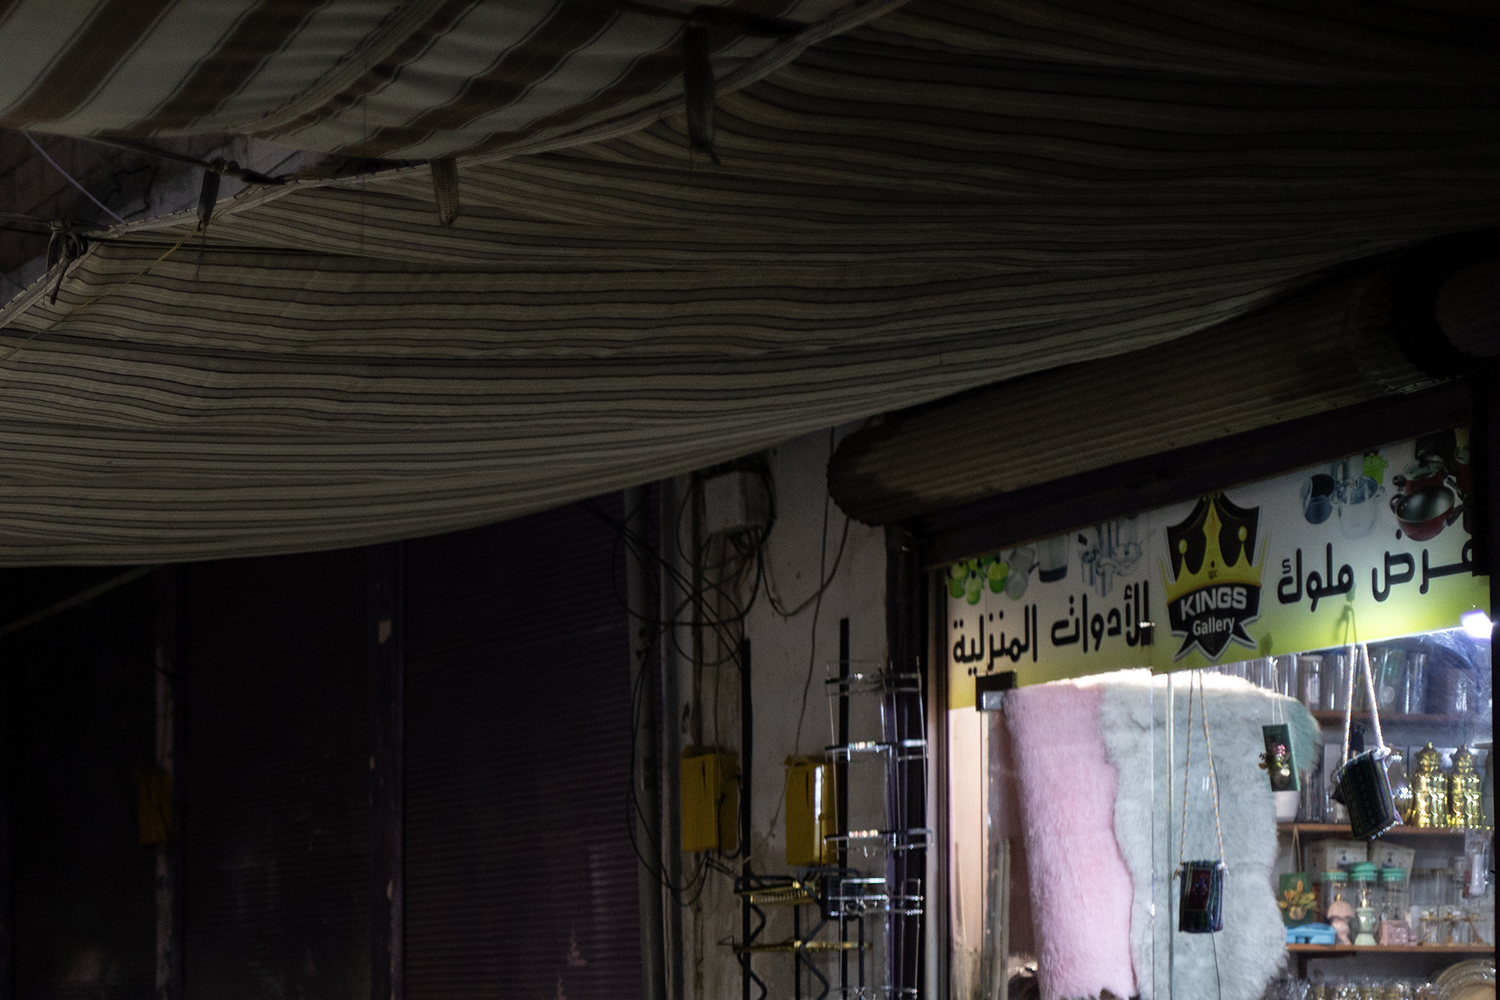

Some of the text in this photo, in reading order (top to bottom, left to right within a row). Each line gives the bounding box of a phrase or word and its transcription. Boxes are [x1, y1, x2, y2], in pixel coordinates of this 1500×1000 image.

[1278, 543, 1354, 612] ملوك
[1180, 587, 1248, 621] KINGS
[1192, 617, 1236, 636] Gallery
[953, 604, 1038, 676] المنزلية
